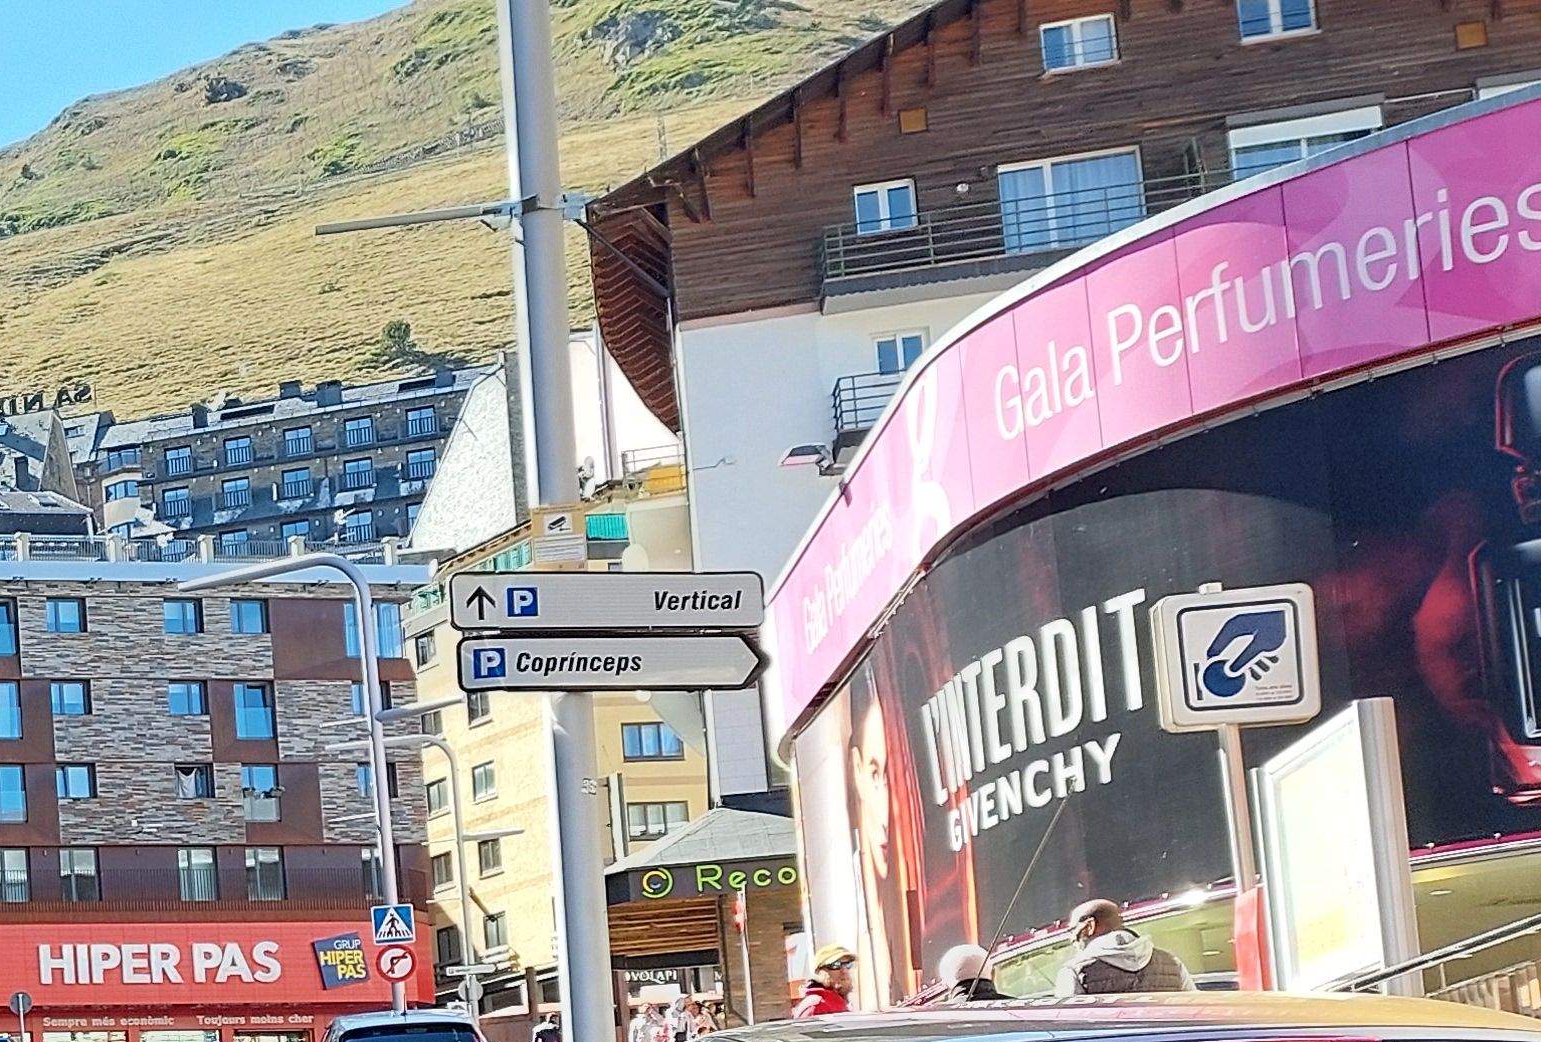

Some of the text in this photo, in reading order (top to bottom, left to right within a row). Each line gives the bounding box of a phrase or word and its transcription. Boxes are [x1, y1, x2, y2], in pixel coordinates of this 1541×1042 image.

[995, 343, 1094, 440] Gala
[514, 590, 742, 614] P Vertical
[481, 651, 643, 676] P Coprínceps
[921, 588, 1146, 806] L'INTERDIT
[948, 732, 1122, 852] GIVENCHY
[696, 865, 797, 892] Reco
[333, 939, 361, 950] GRUP
[38, 940, 283, 986] HIPER PAS
[319, 949, 364, 966] HIPER
[337, 963, 367, 980] PAS
[42, 1016, 88, 1029] Sempre
[196, 1013, 314, 1027] Toujours moins cher
